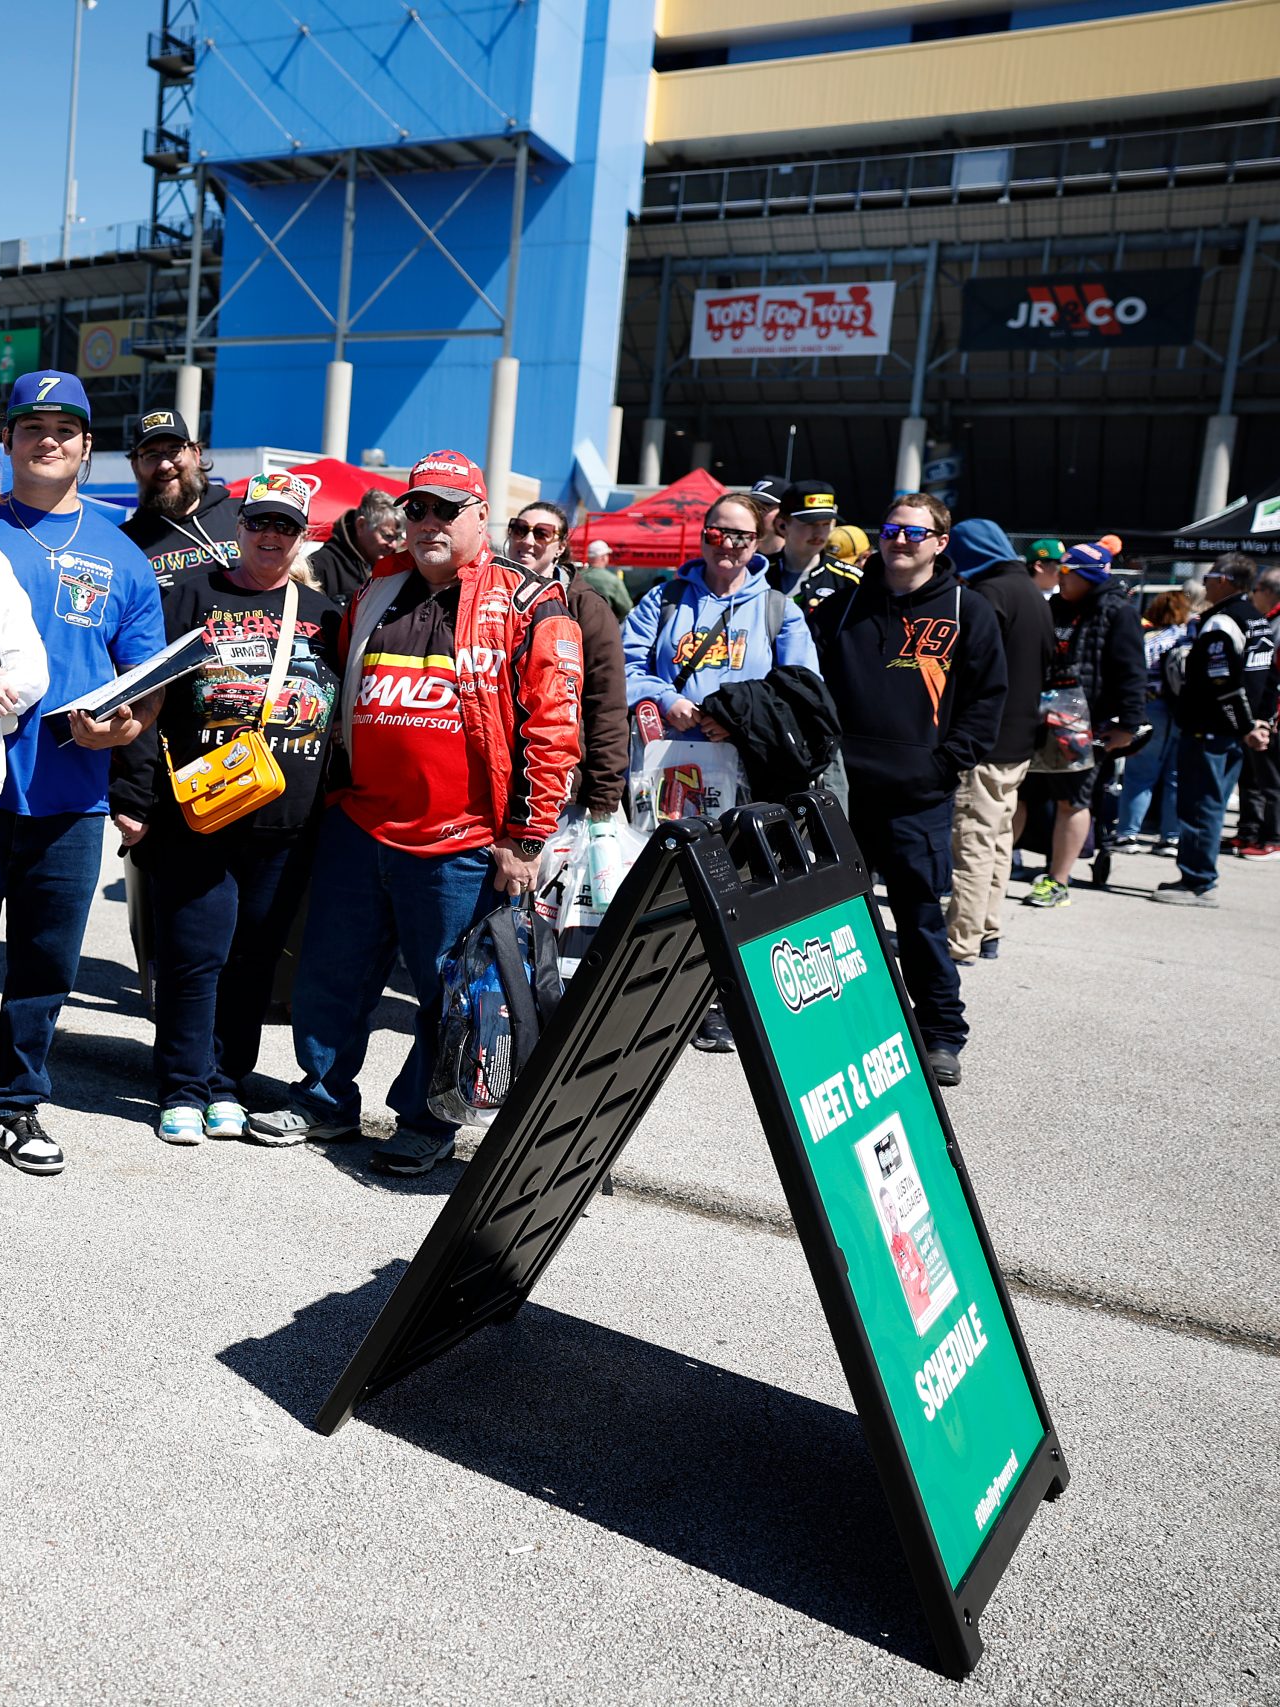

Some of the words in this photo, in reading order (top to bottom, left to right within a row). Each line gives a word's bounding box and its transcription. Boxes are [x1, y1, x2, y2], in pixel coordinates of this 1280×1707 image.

[709, 301, 755, 325] TOYS
[766, 303, 802, 325] FOR
[815, 305, 865, 327] TOTS
[36, 377, 61, 402] 7
[272, 476, 289, 489] 7
[147, 540, 242, 574] OWBOYS
[1173, 539, 1197, 550] The
[1198, 538, 1238, 550] Better
[1241, 540, 1268, 554] Way
[210, 609, 264, 623] USTIN
[230, 646, 256, 659] JRM
[899, 616, 959, 660] 19
[353, 673, 462, 713] RAND
[374, 711, 465, 734] Anniversary
[200, 729, 226, 746] HE
[269, 736, 322, 756] FILES
[830, 924, 857, 957] AUTO
[773, 941, 839, 1009] O'Reilly
[835, 949, 868, 985] PARTS
[799, 1070, 855, 1144] MEET
[847, 1063, 871, 1110] &
[861, 1031, 913, 1099] GREET
[914, 1302, 989, 1422] SCHEDULE
